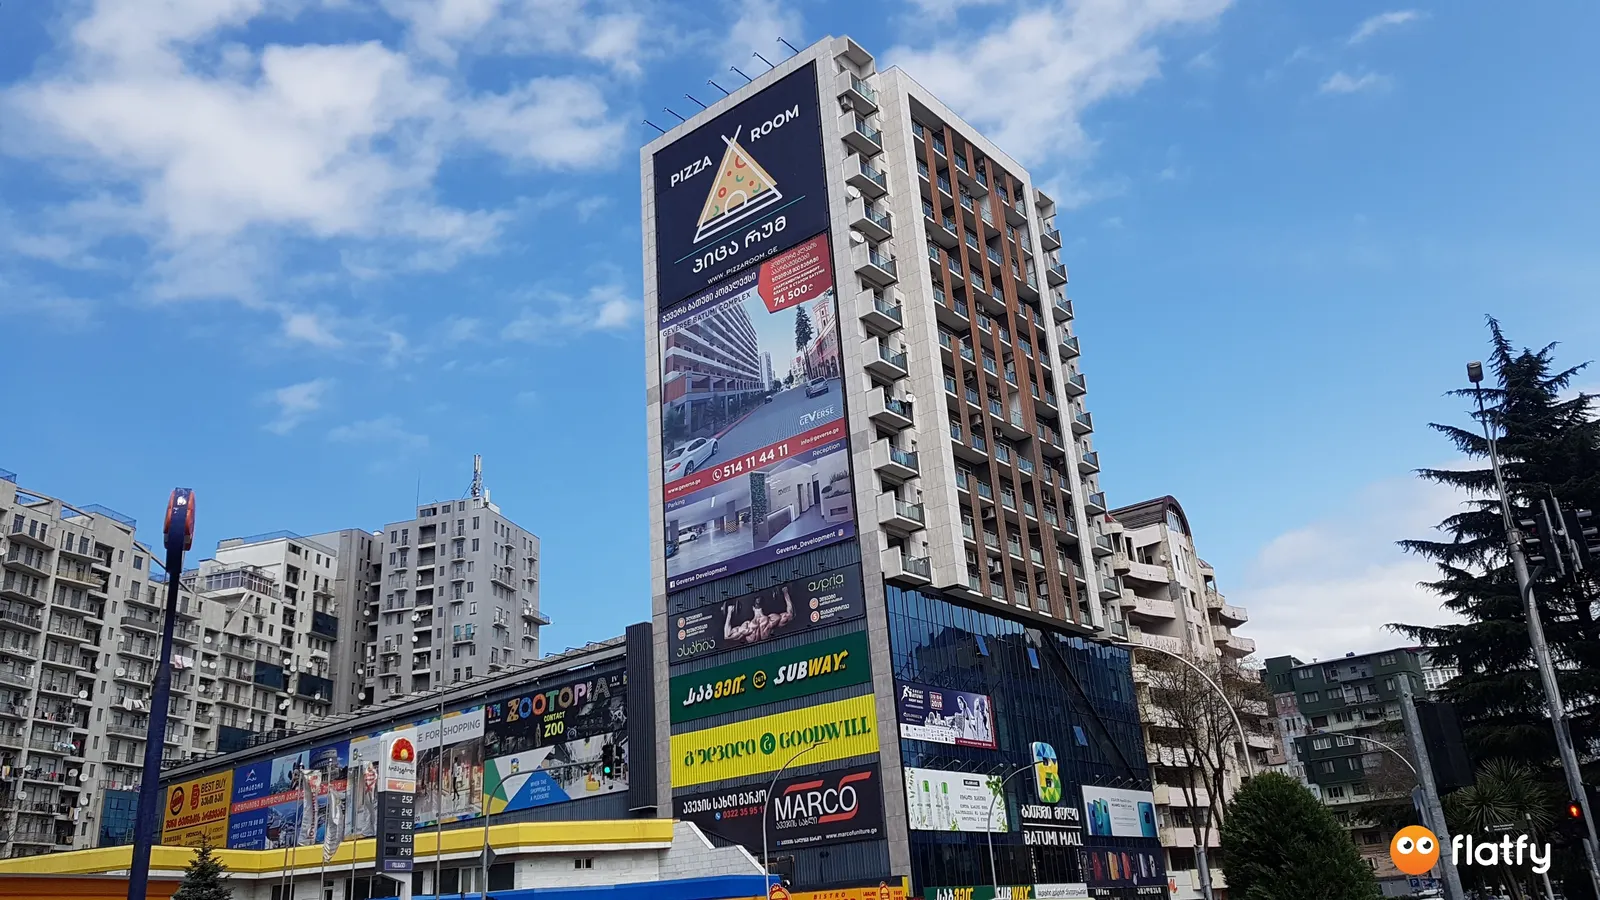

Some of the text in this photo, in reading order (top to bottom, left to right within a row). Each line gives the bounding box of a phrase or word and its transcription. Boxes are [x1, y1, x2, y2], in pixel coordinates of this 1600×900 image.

[750, 104, 800, 142] ROOM
[670, 155, 712, 188] PIZZA
[692, 215, 787, 273] პიცა რუმ
[662, 319, 692, 337] GEVERSE
[718, 290, 752, 313] COMPLEX
[774, 296, 785, 308] 74
[722, 444, 789, 478] 514 11 44 11
[812, 442, 841, 457] Reception
[667, 478, 702, 494] www.geverse.ge
[667, 498, 686, 510] Parking
[776, 530, 836, 556] Geverse_Development
[676, 564, 728, 588] Geverse Development
[808, 572, 844, 592] aspria
[773, 649, 848, 686] SUBWAY
[506, 677, 610, 722] ZOOTOPIA
[683, 674, 746, 706] საბვეი
[543, 710, 565, 722] CONTACT
[425, 730, 440, 741] FOR
[443, 718, 481, 736] SHOPPING
[544, 720, 564, 738] ZOO
[780, 716, 872, 749] GOODWILL
[684, 739, 756, 768] გუდვილი
[201, 777, 227, 793] BEST BUY
[683, 790, 767, 815] ავეჯის სახლი მარკო
[722, 809, 739, 820] 0322
[740, 808, 748, 816] 35
[749, 806, 758, 815] 95
[774, 785, 858, 822] MARCO
[1024, 830, 1084, 846] BATUMI MALL
[995, 884, 1031, 900] SUBWAY
